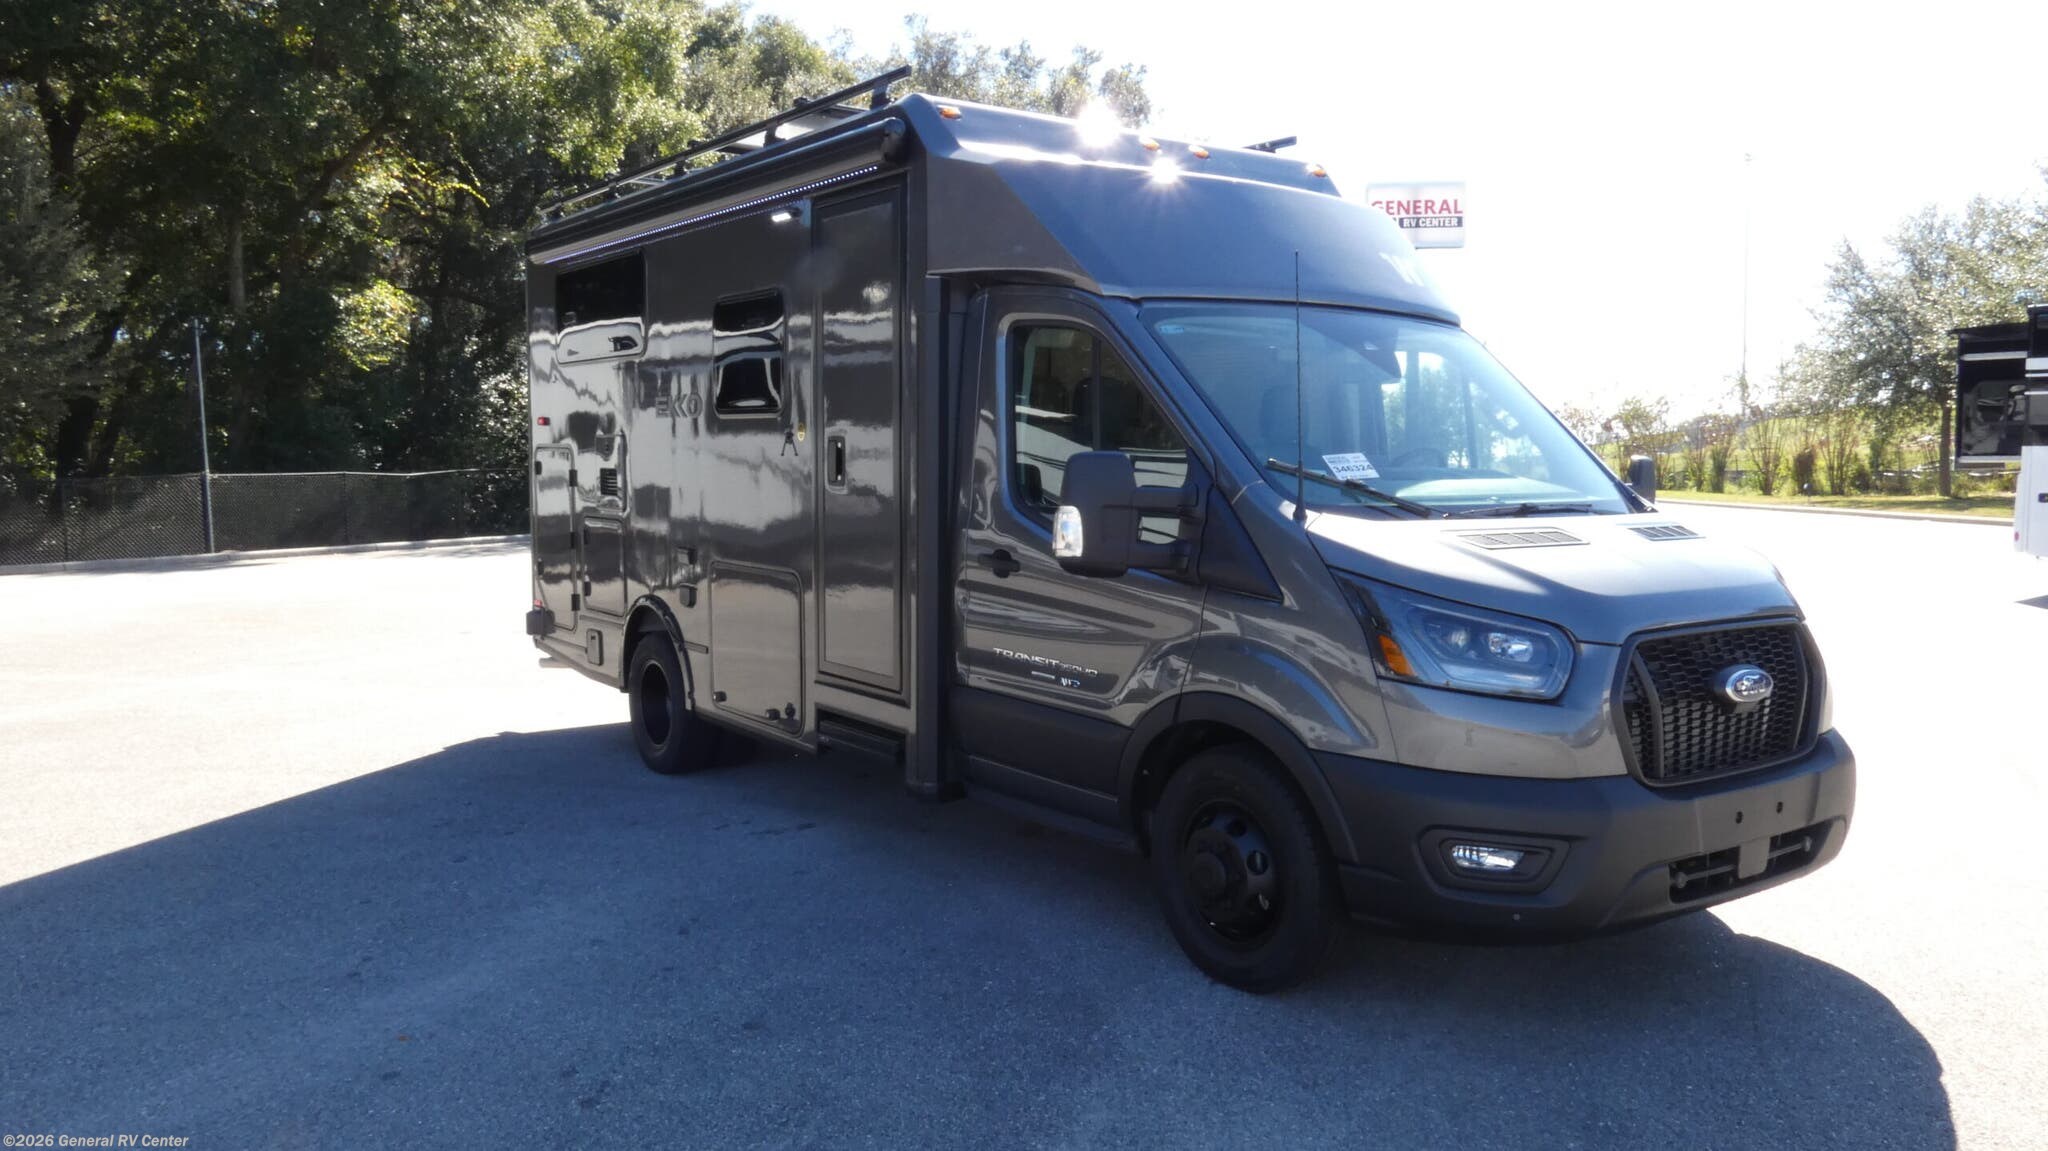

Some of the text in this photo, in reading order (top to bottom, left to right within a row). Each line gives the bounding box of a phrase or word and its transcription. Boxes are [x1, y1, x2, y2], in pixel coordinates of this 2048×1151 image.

[1403, 217, 1459, 228] RV CENTER
[993, 647, 1060, 667] TRANSIT
